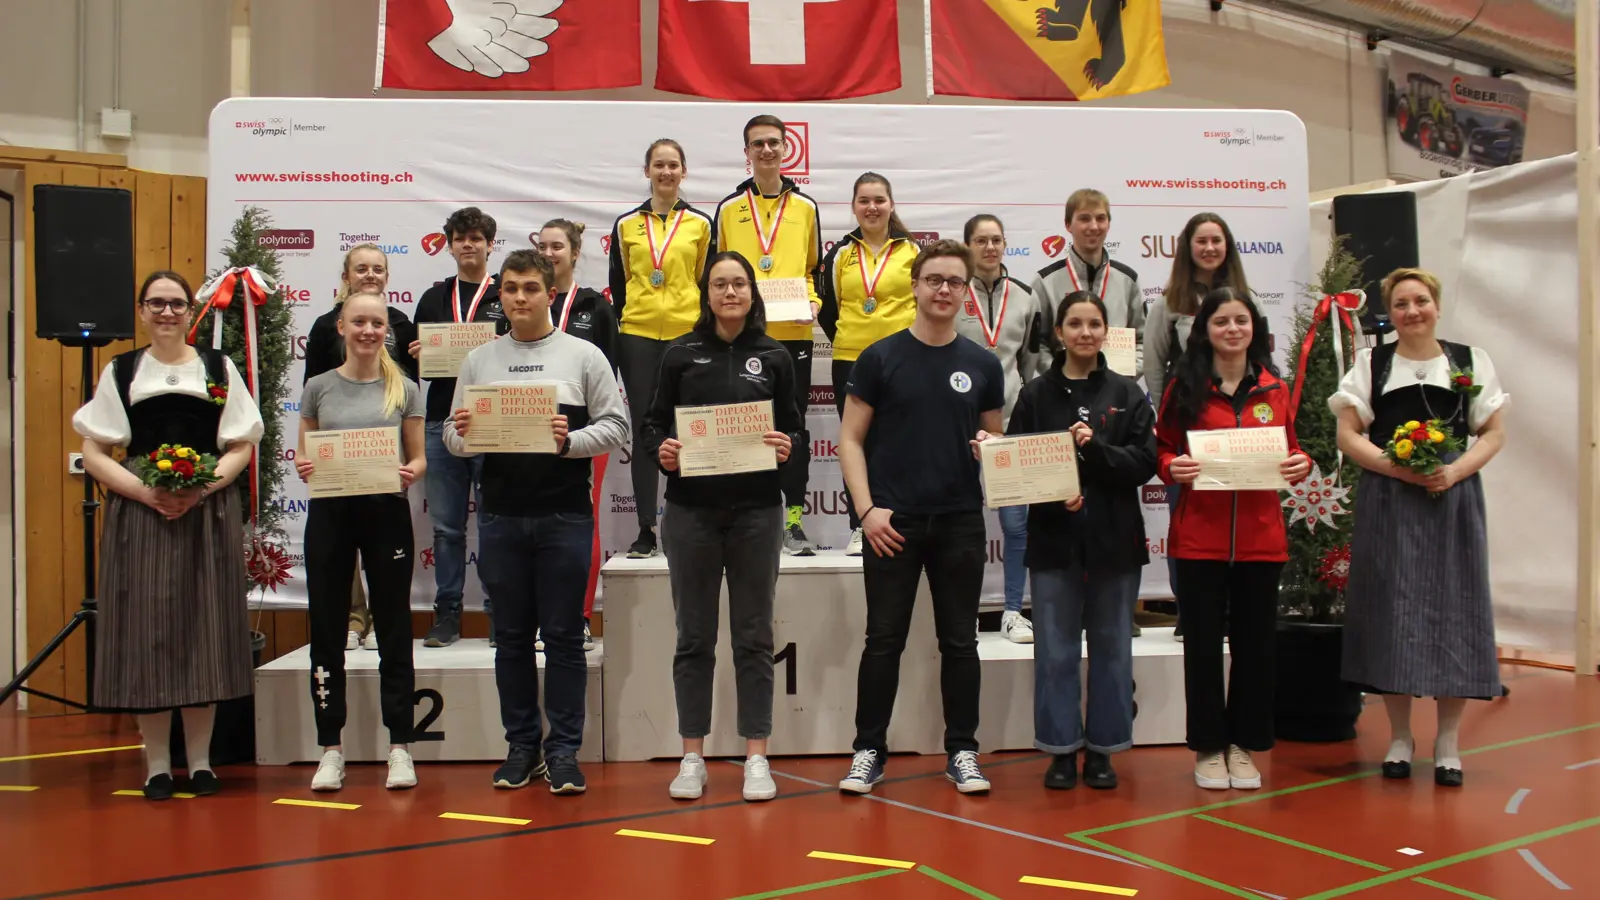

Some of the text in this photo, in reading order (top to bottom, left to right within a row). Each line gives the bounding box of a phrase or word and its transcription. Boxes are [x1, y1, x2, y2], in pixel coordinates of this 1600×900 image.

[243, 120, 266, 128] swiss
[252, 124, 326, 136] olympic Member
[1220, 134, 1285, 146] olympic Member
[235, 171, 413, 185] www.swissshooting.ch
[1126, 178, 1287, 192] www.swissshooting.ch
[258, 232, 311, 247] polytronic
[339, 232, 381, 243] Together
[1004, 247, 1030, 256] UAG
[762, 279, 797, 287] DIPLOM
[763, 293, 805, 301] DIPLOMA
[450, 324, 485, 332] DIPLOM
[508, 364, 544, 373] LACOSTE
[501, 387, 543, 397] DIPLOM
[501, 406, 554, 416] DIPLOMA
[715, 404, 759, 417] DIPLOM
[342, 430, 386, 440] DIPLOM
[717, 423, 771, 436] DIPLOMA
[1018, 435, 1060, 448] DIPLOM
[343, 448, 397, 459] DIPLOMA
[1230, 445, 1284, 453] DIPLOMA
[1020, 454, 1073, 467] DIPLOMA
[773, 642, 797, 695] 1
[413, 688, 445, 742] 2
